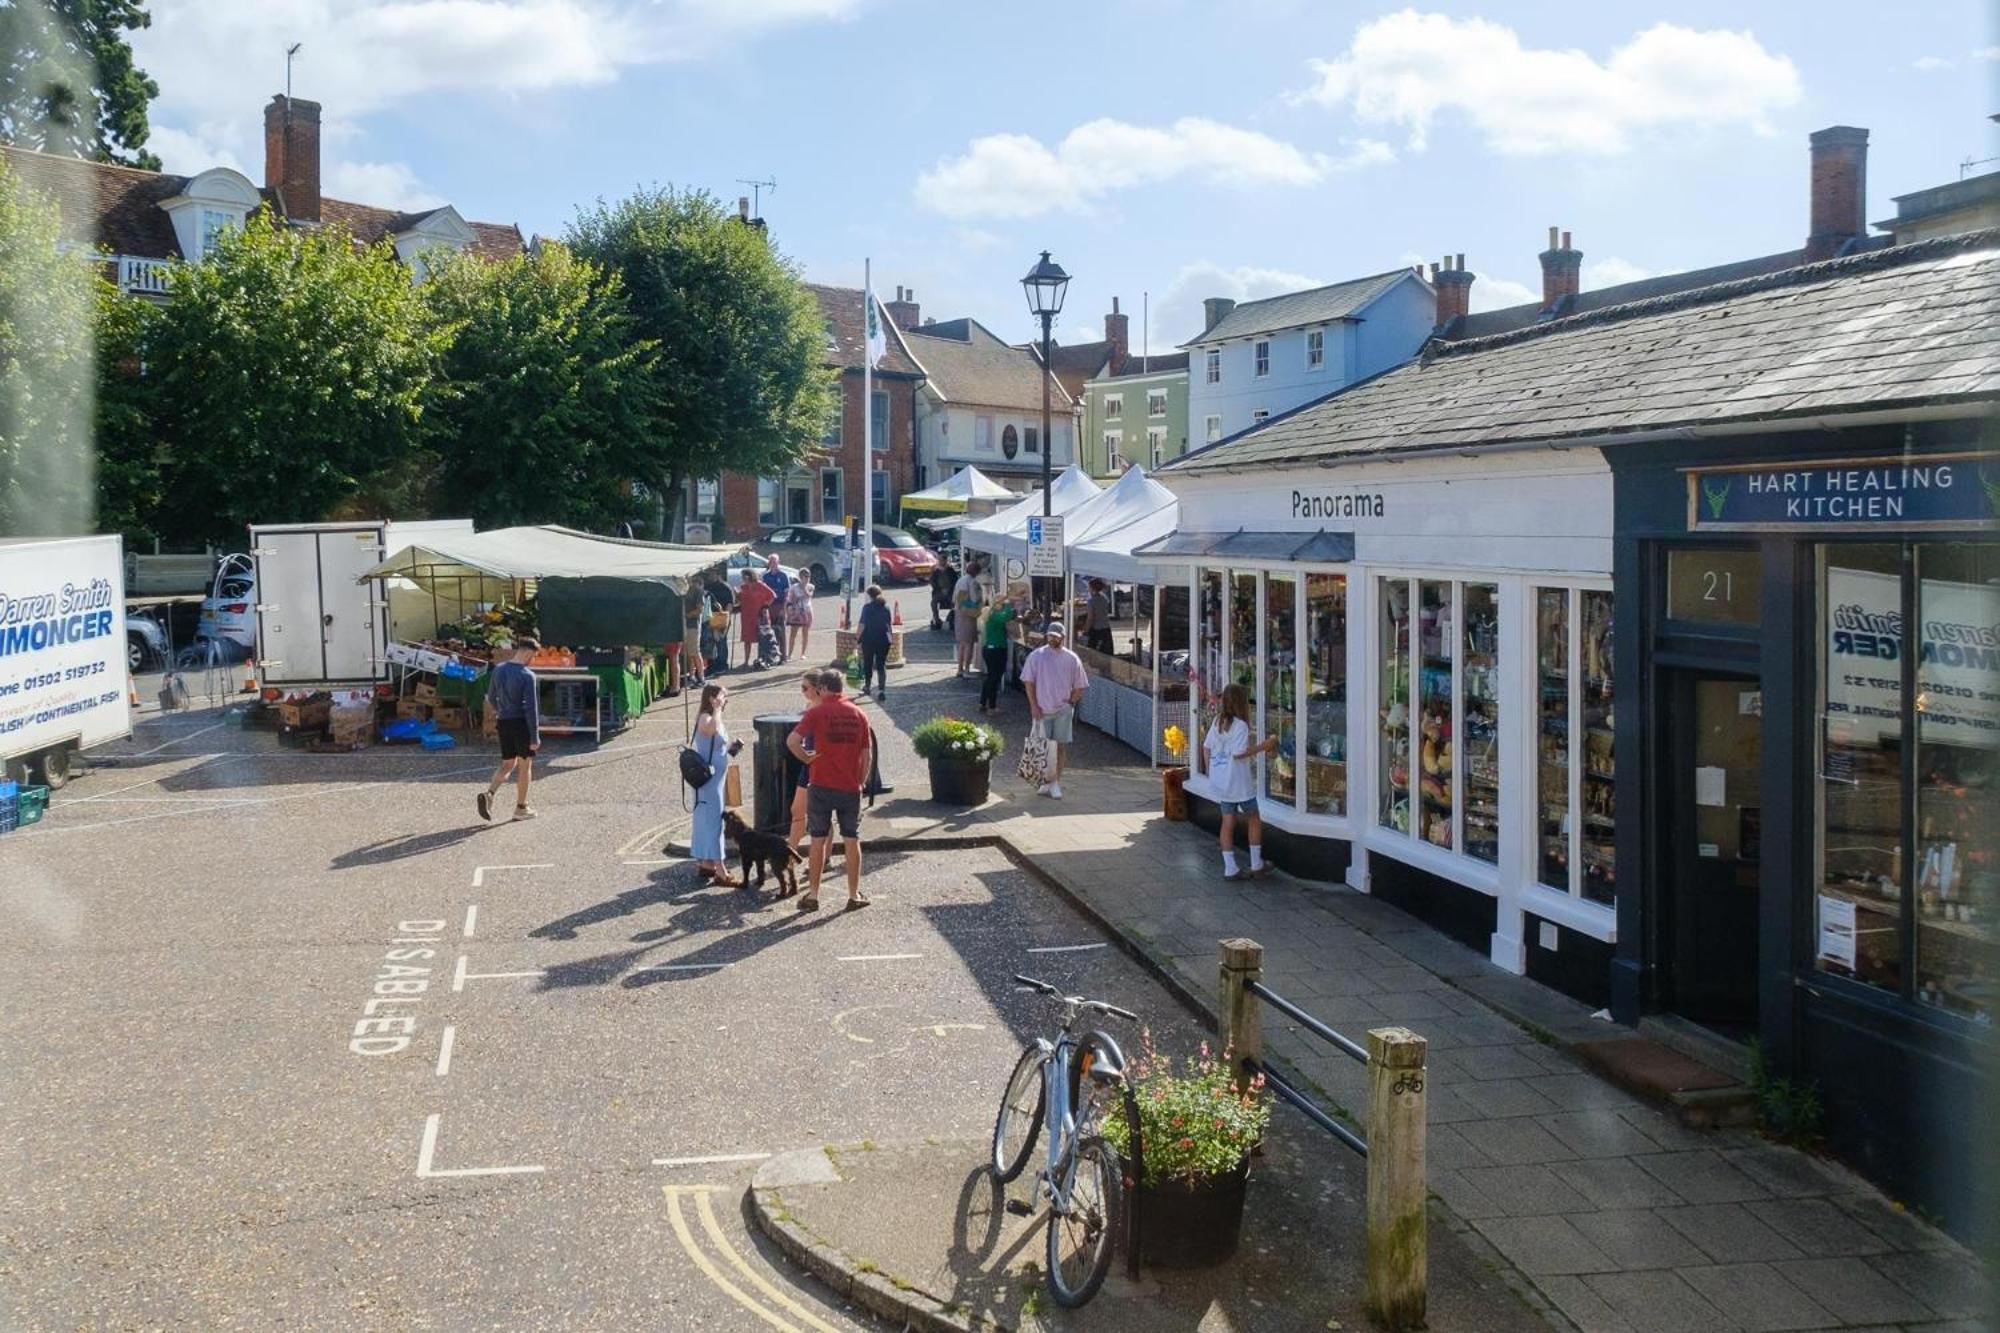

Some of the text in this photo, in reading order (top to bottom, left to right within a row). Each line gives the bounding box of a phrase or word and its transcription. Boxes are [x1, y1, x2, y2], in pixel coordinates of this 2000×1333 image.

[1748, 466, 1953, 495] HART HEALING
[1291, 490, 1384, 518] Panorama
[1787, 496, 1904, 518] KITCHEN
[60, 578, 113, 615] Smith
[1702, 570, 1733, 602] 21
[24, 670, 61, 691] 01502
[65, 661, 106, 681] 519732
[36, 698, 98, 724] CONTINENTAL
[349, 919, 446, 1056] DISABLED
